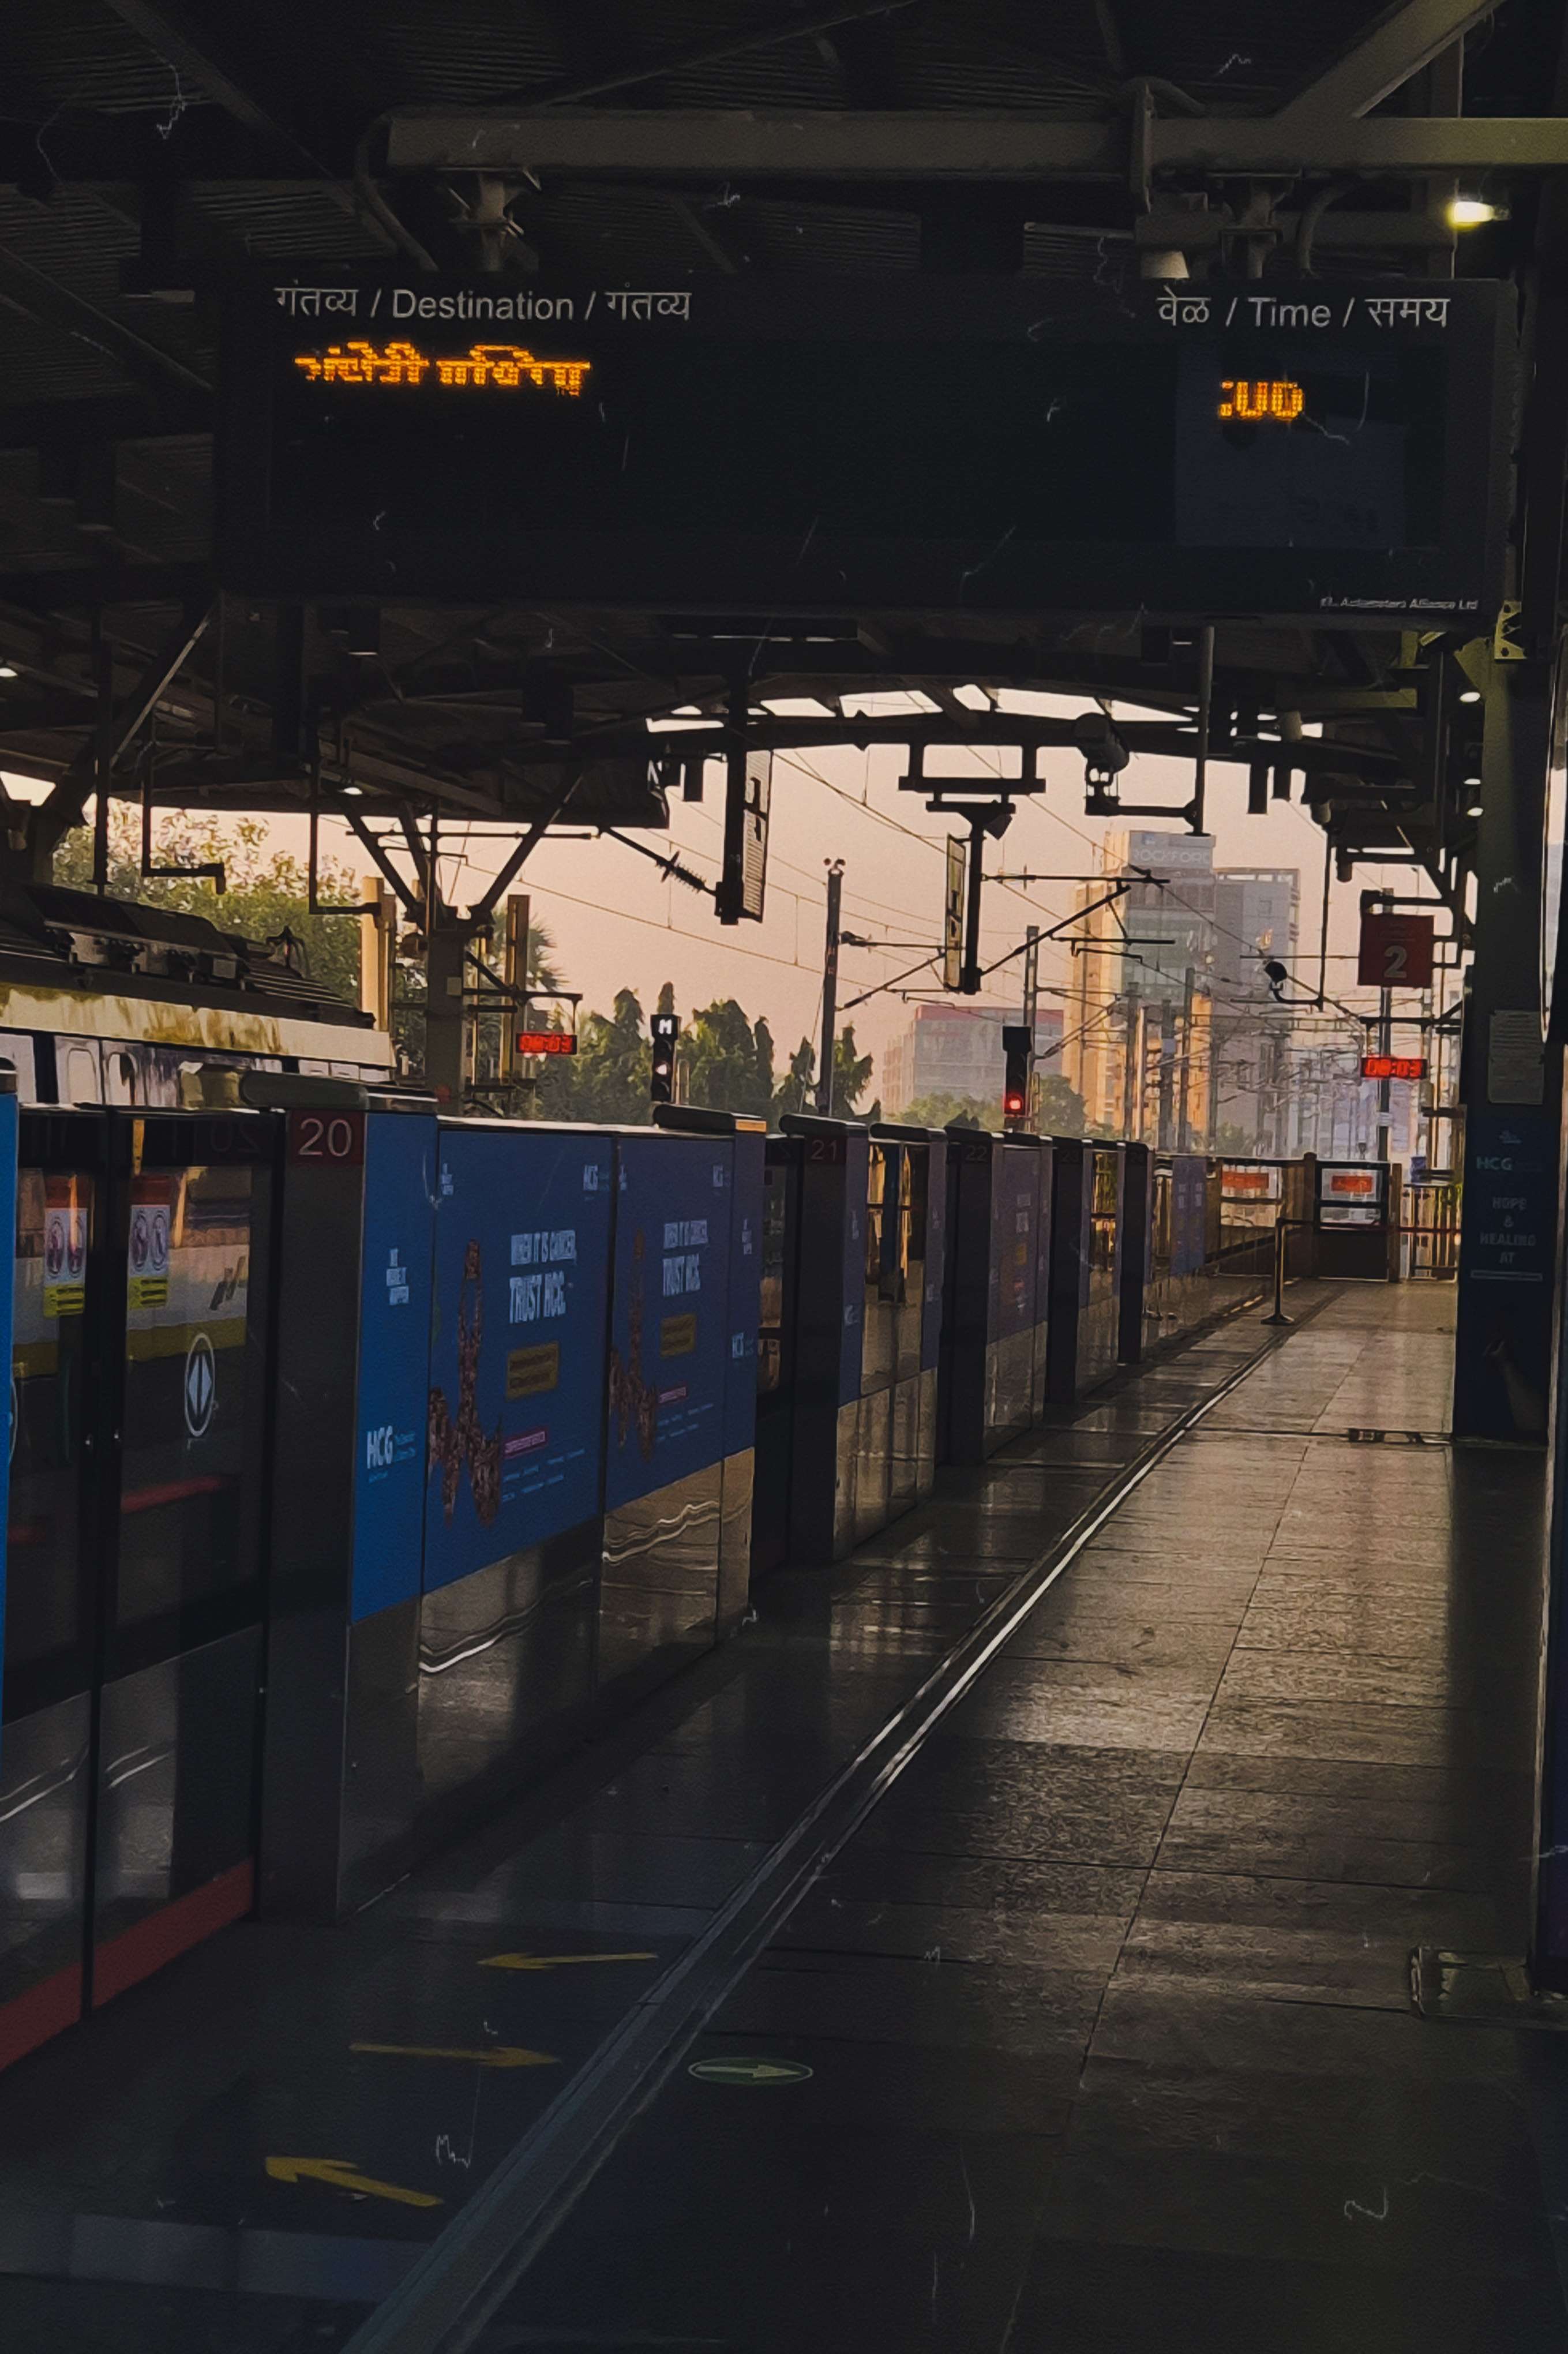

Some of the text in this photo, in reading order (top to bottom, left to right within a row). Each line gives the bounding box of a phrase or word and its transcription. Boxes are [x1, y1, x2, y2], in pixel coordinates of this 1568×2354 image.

[273, 279, 358, 317] गंतव्य
[392, 289, 574, 321] Destination
[605, 282, 692, 321] गंतव्य
[1156, 286, 1210, 327] वेळ
[1248, 297, 1331, 328] Time
[1365, 298, 1451, 328] समय
[1385, 944, 1407, 979] 2
[298, 1118, 352, 1157] 20
[811, 1139, 837, 1161] 21
[965, 1145, 987, 1162] 22
[1476, 1156, 1513, 1171] HCG
[1492, 1197, 1527, 1210] HOPE
[1499, 1251, 1516, 1264] AT
[367, 1425, 393, 1469] HCG
